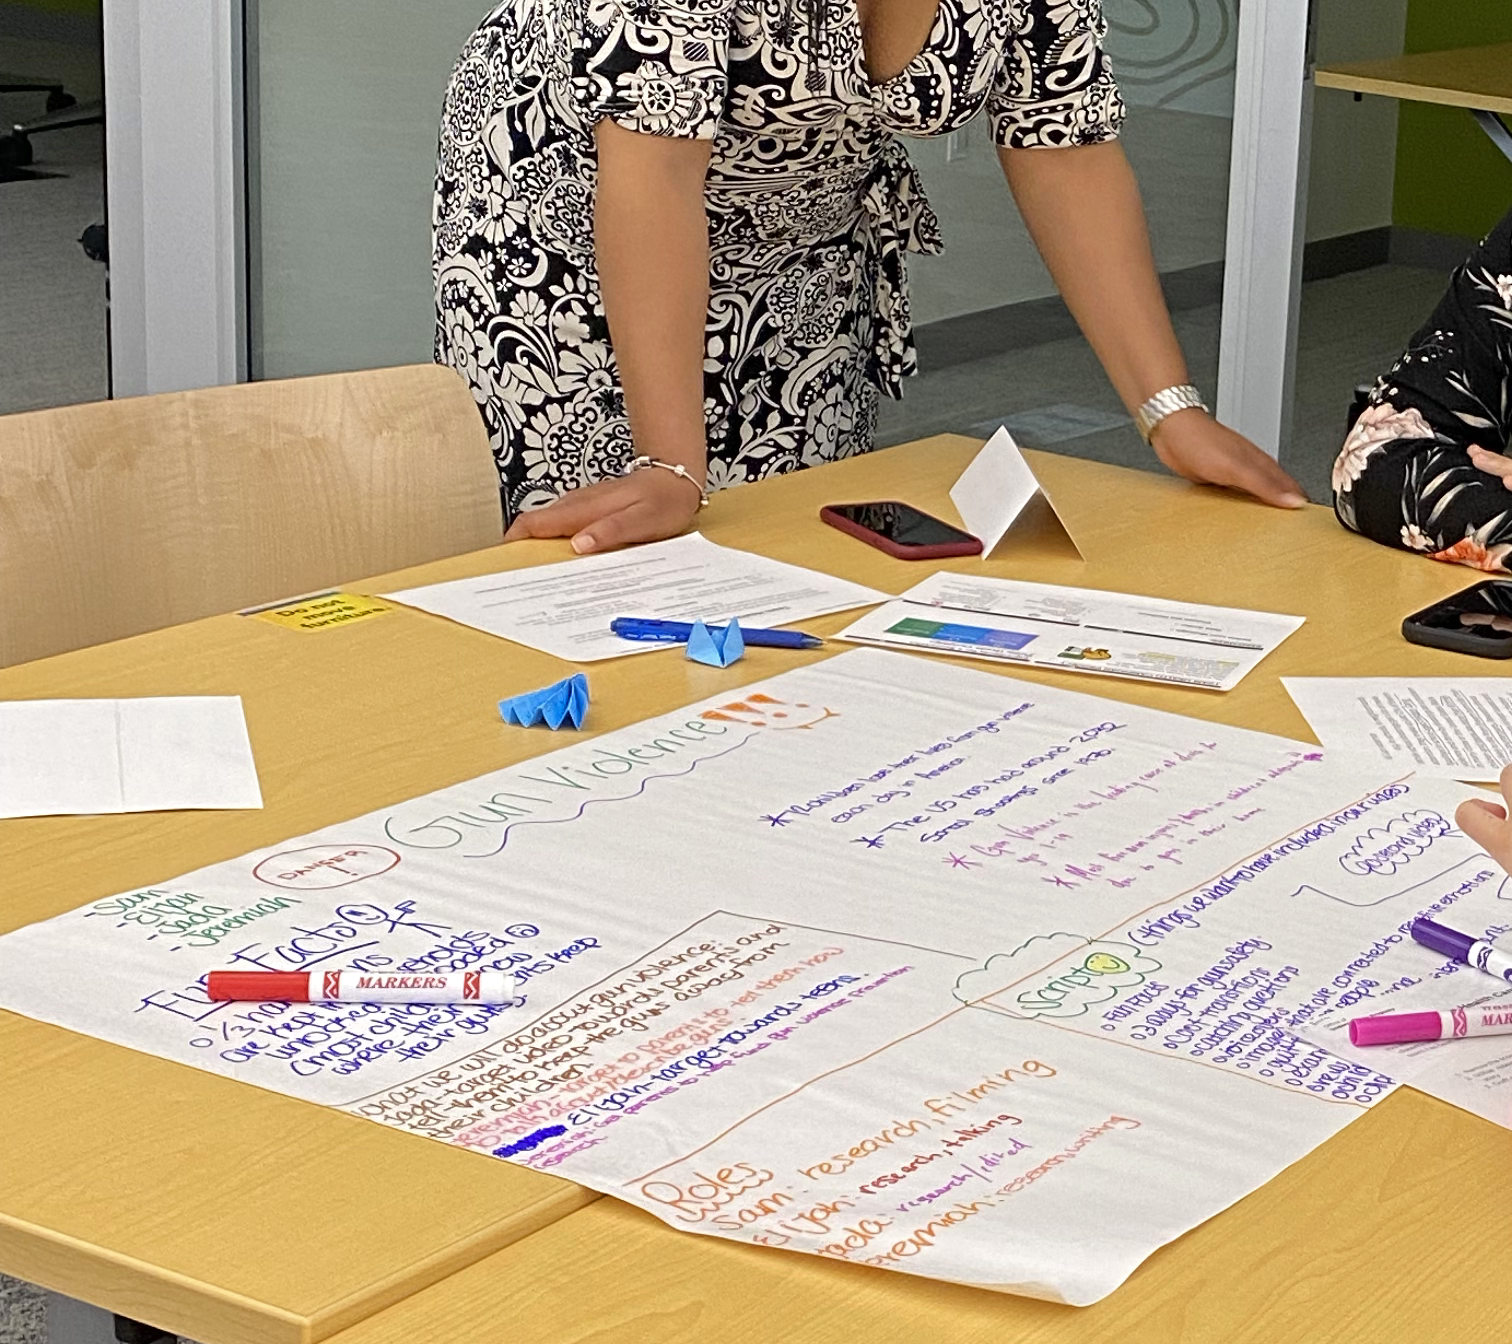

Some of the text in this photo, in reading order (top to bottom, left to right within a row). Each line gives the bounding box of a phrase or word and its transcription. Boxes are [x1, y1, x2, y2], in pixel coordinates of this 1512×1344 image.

[276, 599, 345, 618] Do not
[303, 606, 355, 620] move
[385, 792, 552, 849] Gun
[876, 816, 931, 833] The
[736, 924, 787, 946] and
[356, 976, 448, 989] MARKERS
[1017, 967, 1106, 1018] Script
[641, 1162, 766, 1213] Roles
